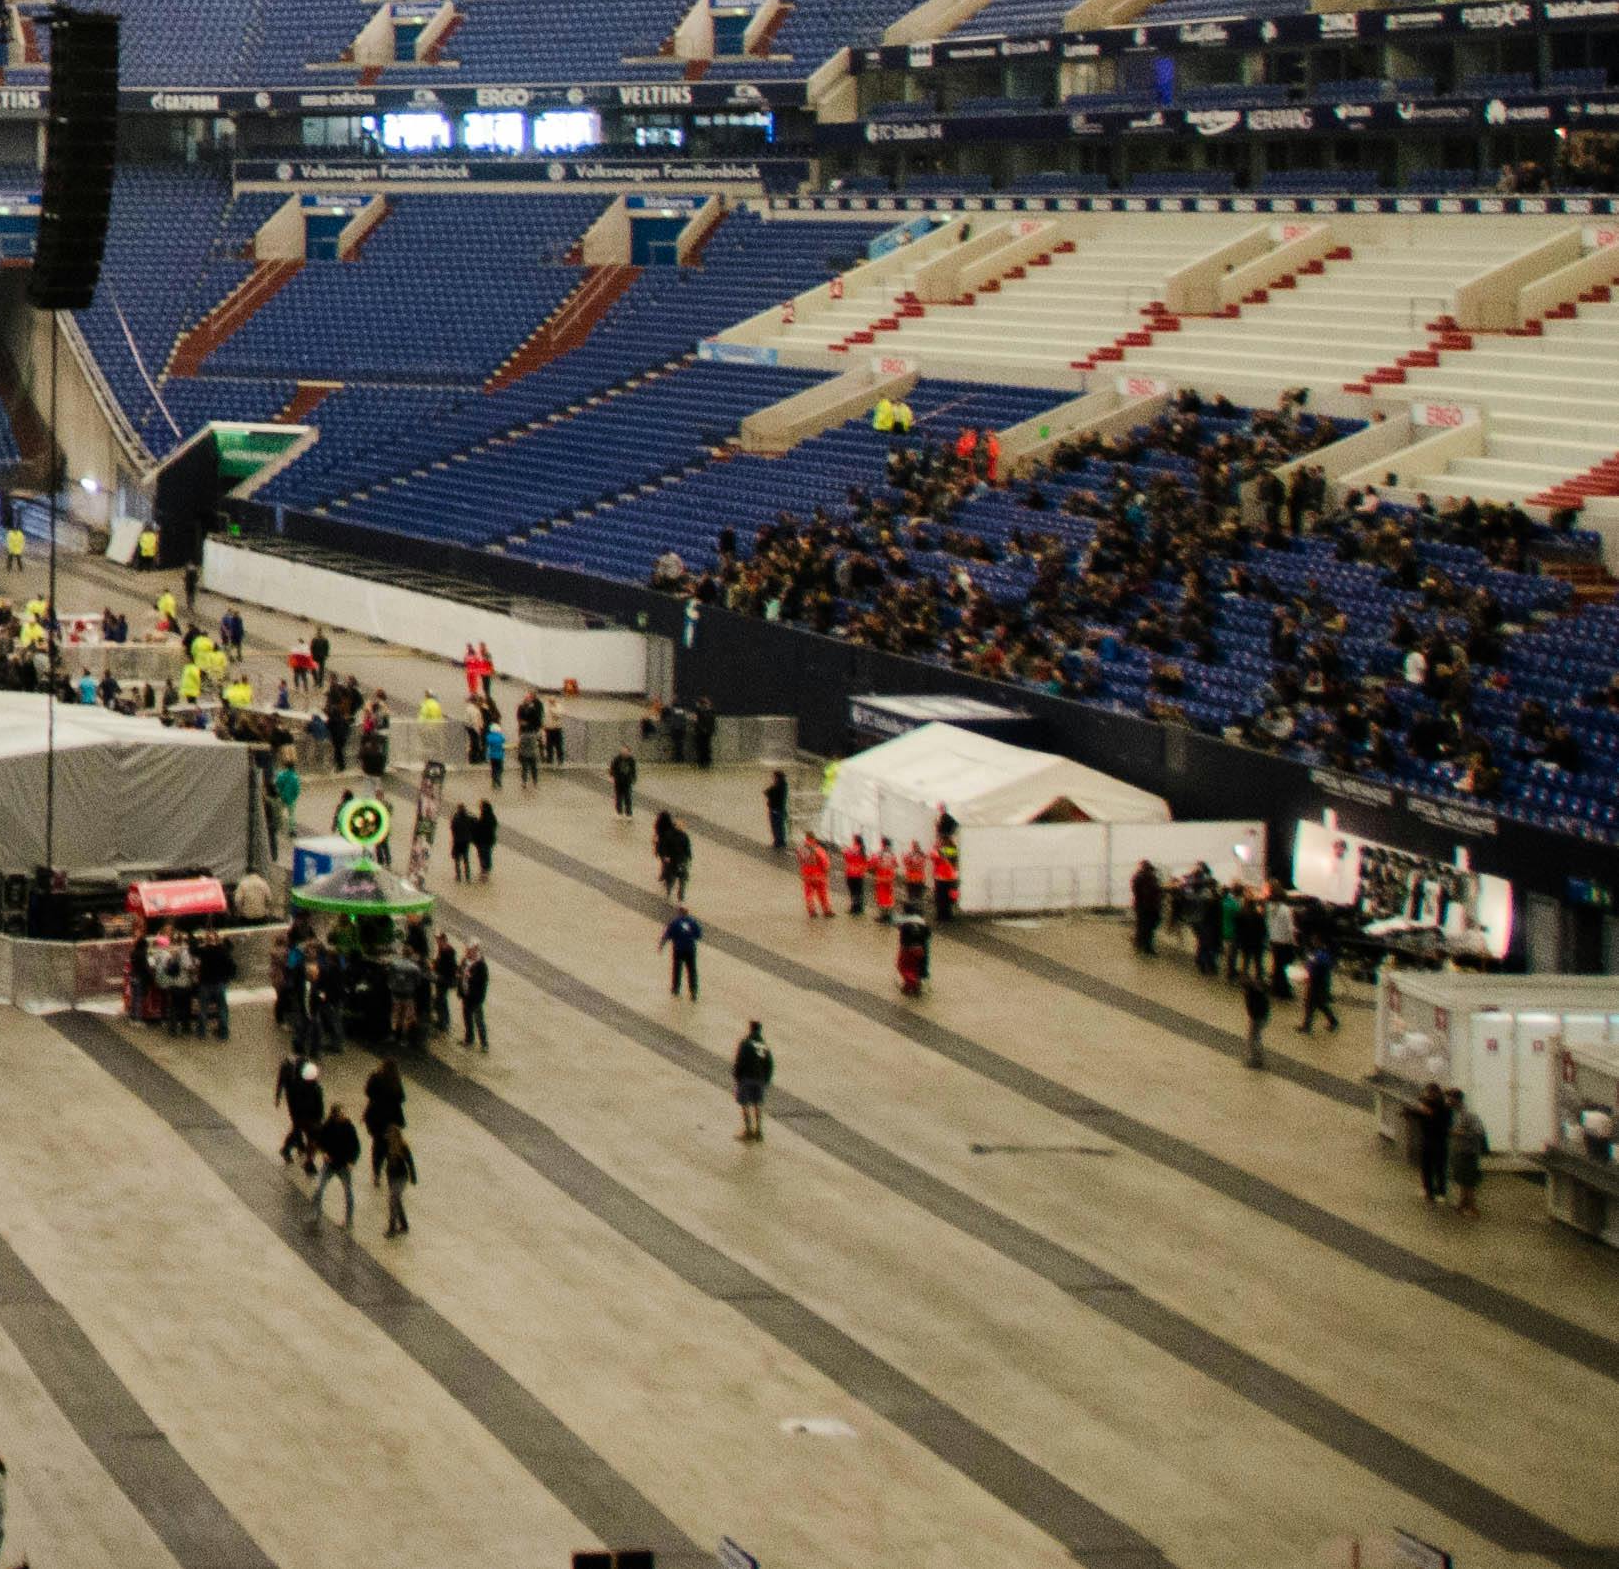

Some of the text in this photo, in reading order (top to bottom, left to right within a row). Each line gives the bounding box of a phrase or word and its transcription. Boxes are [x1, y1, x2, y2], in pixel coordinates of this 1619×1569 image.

[475, 88, 529, 107] ERGO
[618, 86, 693, 105] VELTINS
[300, 163, 470, 182] Volkswagen Familienblock
[575, 163, 761, 182] Volkswagen Familienblock
